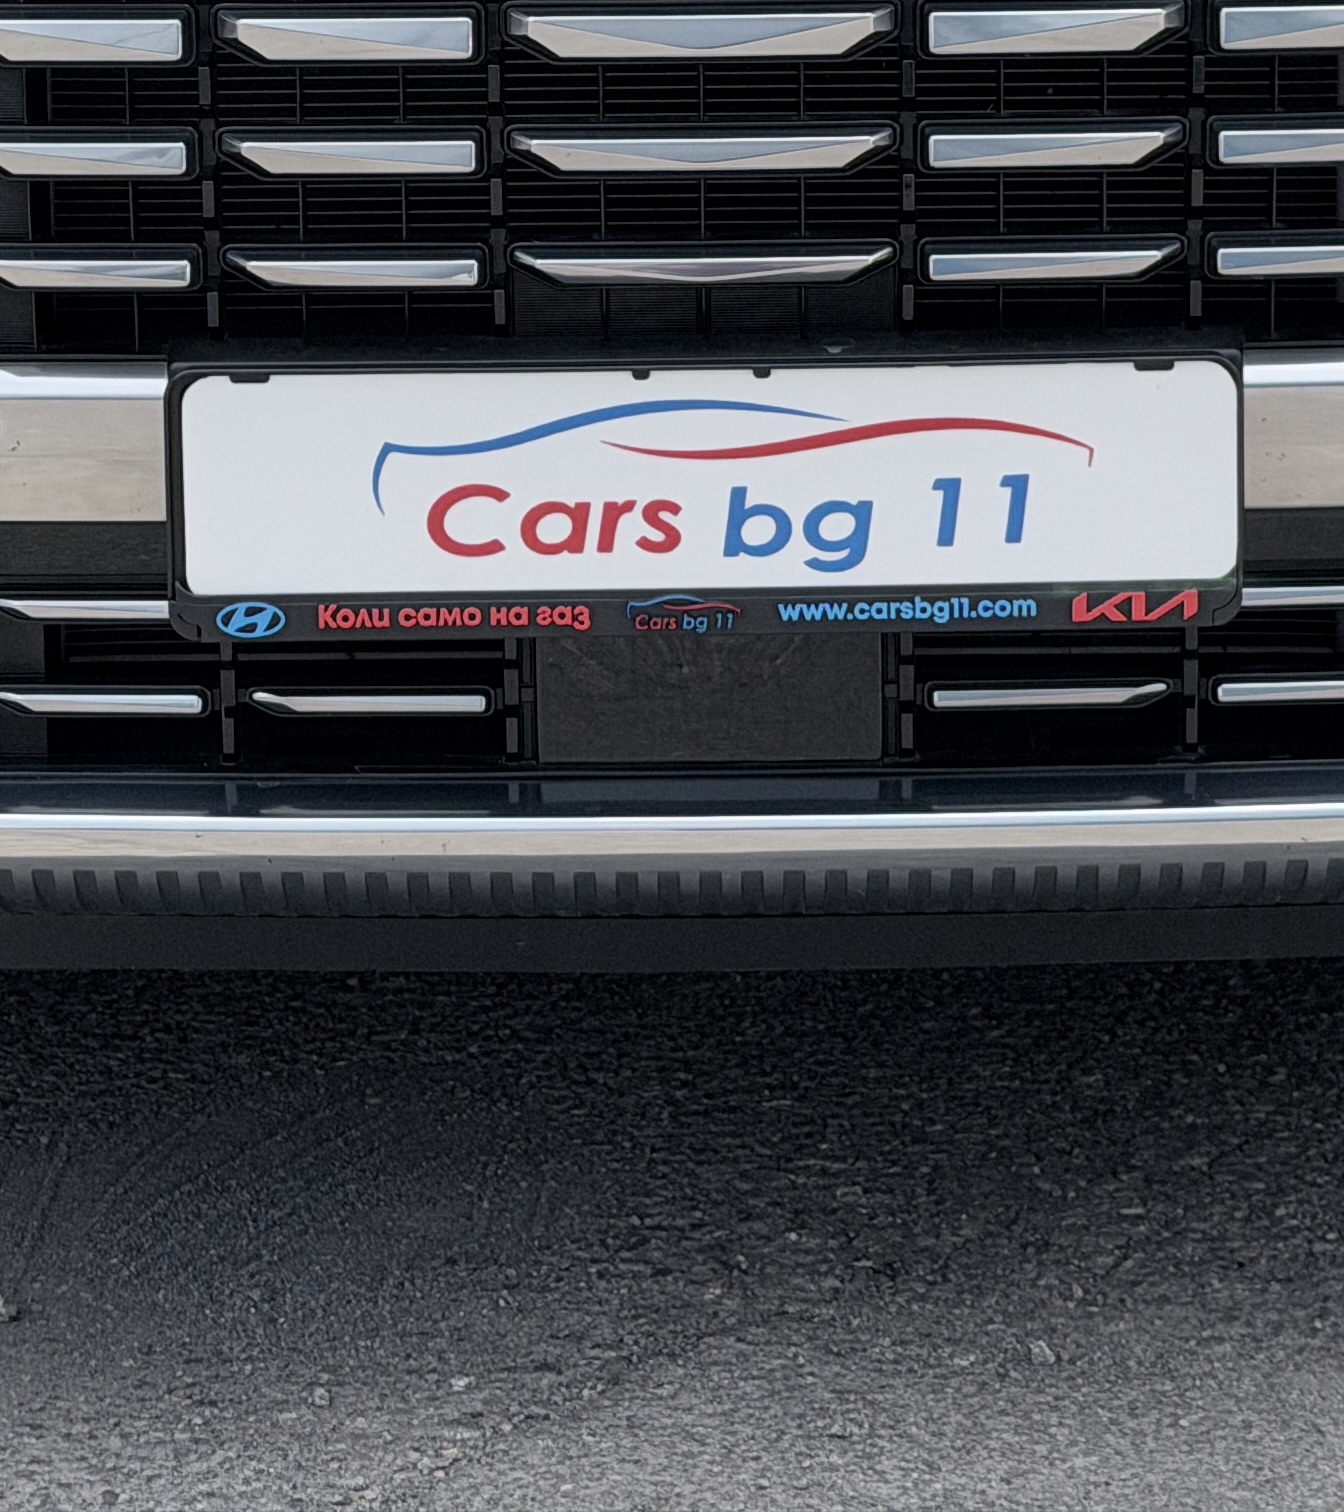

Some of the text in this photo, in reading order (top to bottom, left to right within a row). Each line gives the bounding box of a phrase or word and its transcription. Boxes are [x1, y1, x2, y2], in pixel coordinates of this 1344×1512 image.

[426, 474, 1030, 573] Cars bg 11
[317, 603, 591, 631] Коли само на газ
[635, 612, 734, 633] Cars bg 11
[778, 596, 1037, 623] www.carsbg11.com
